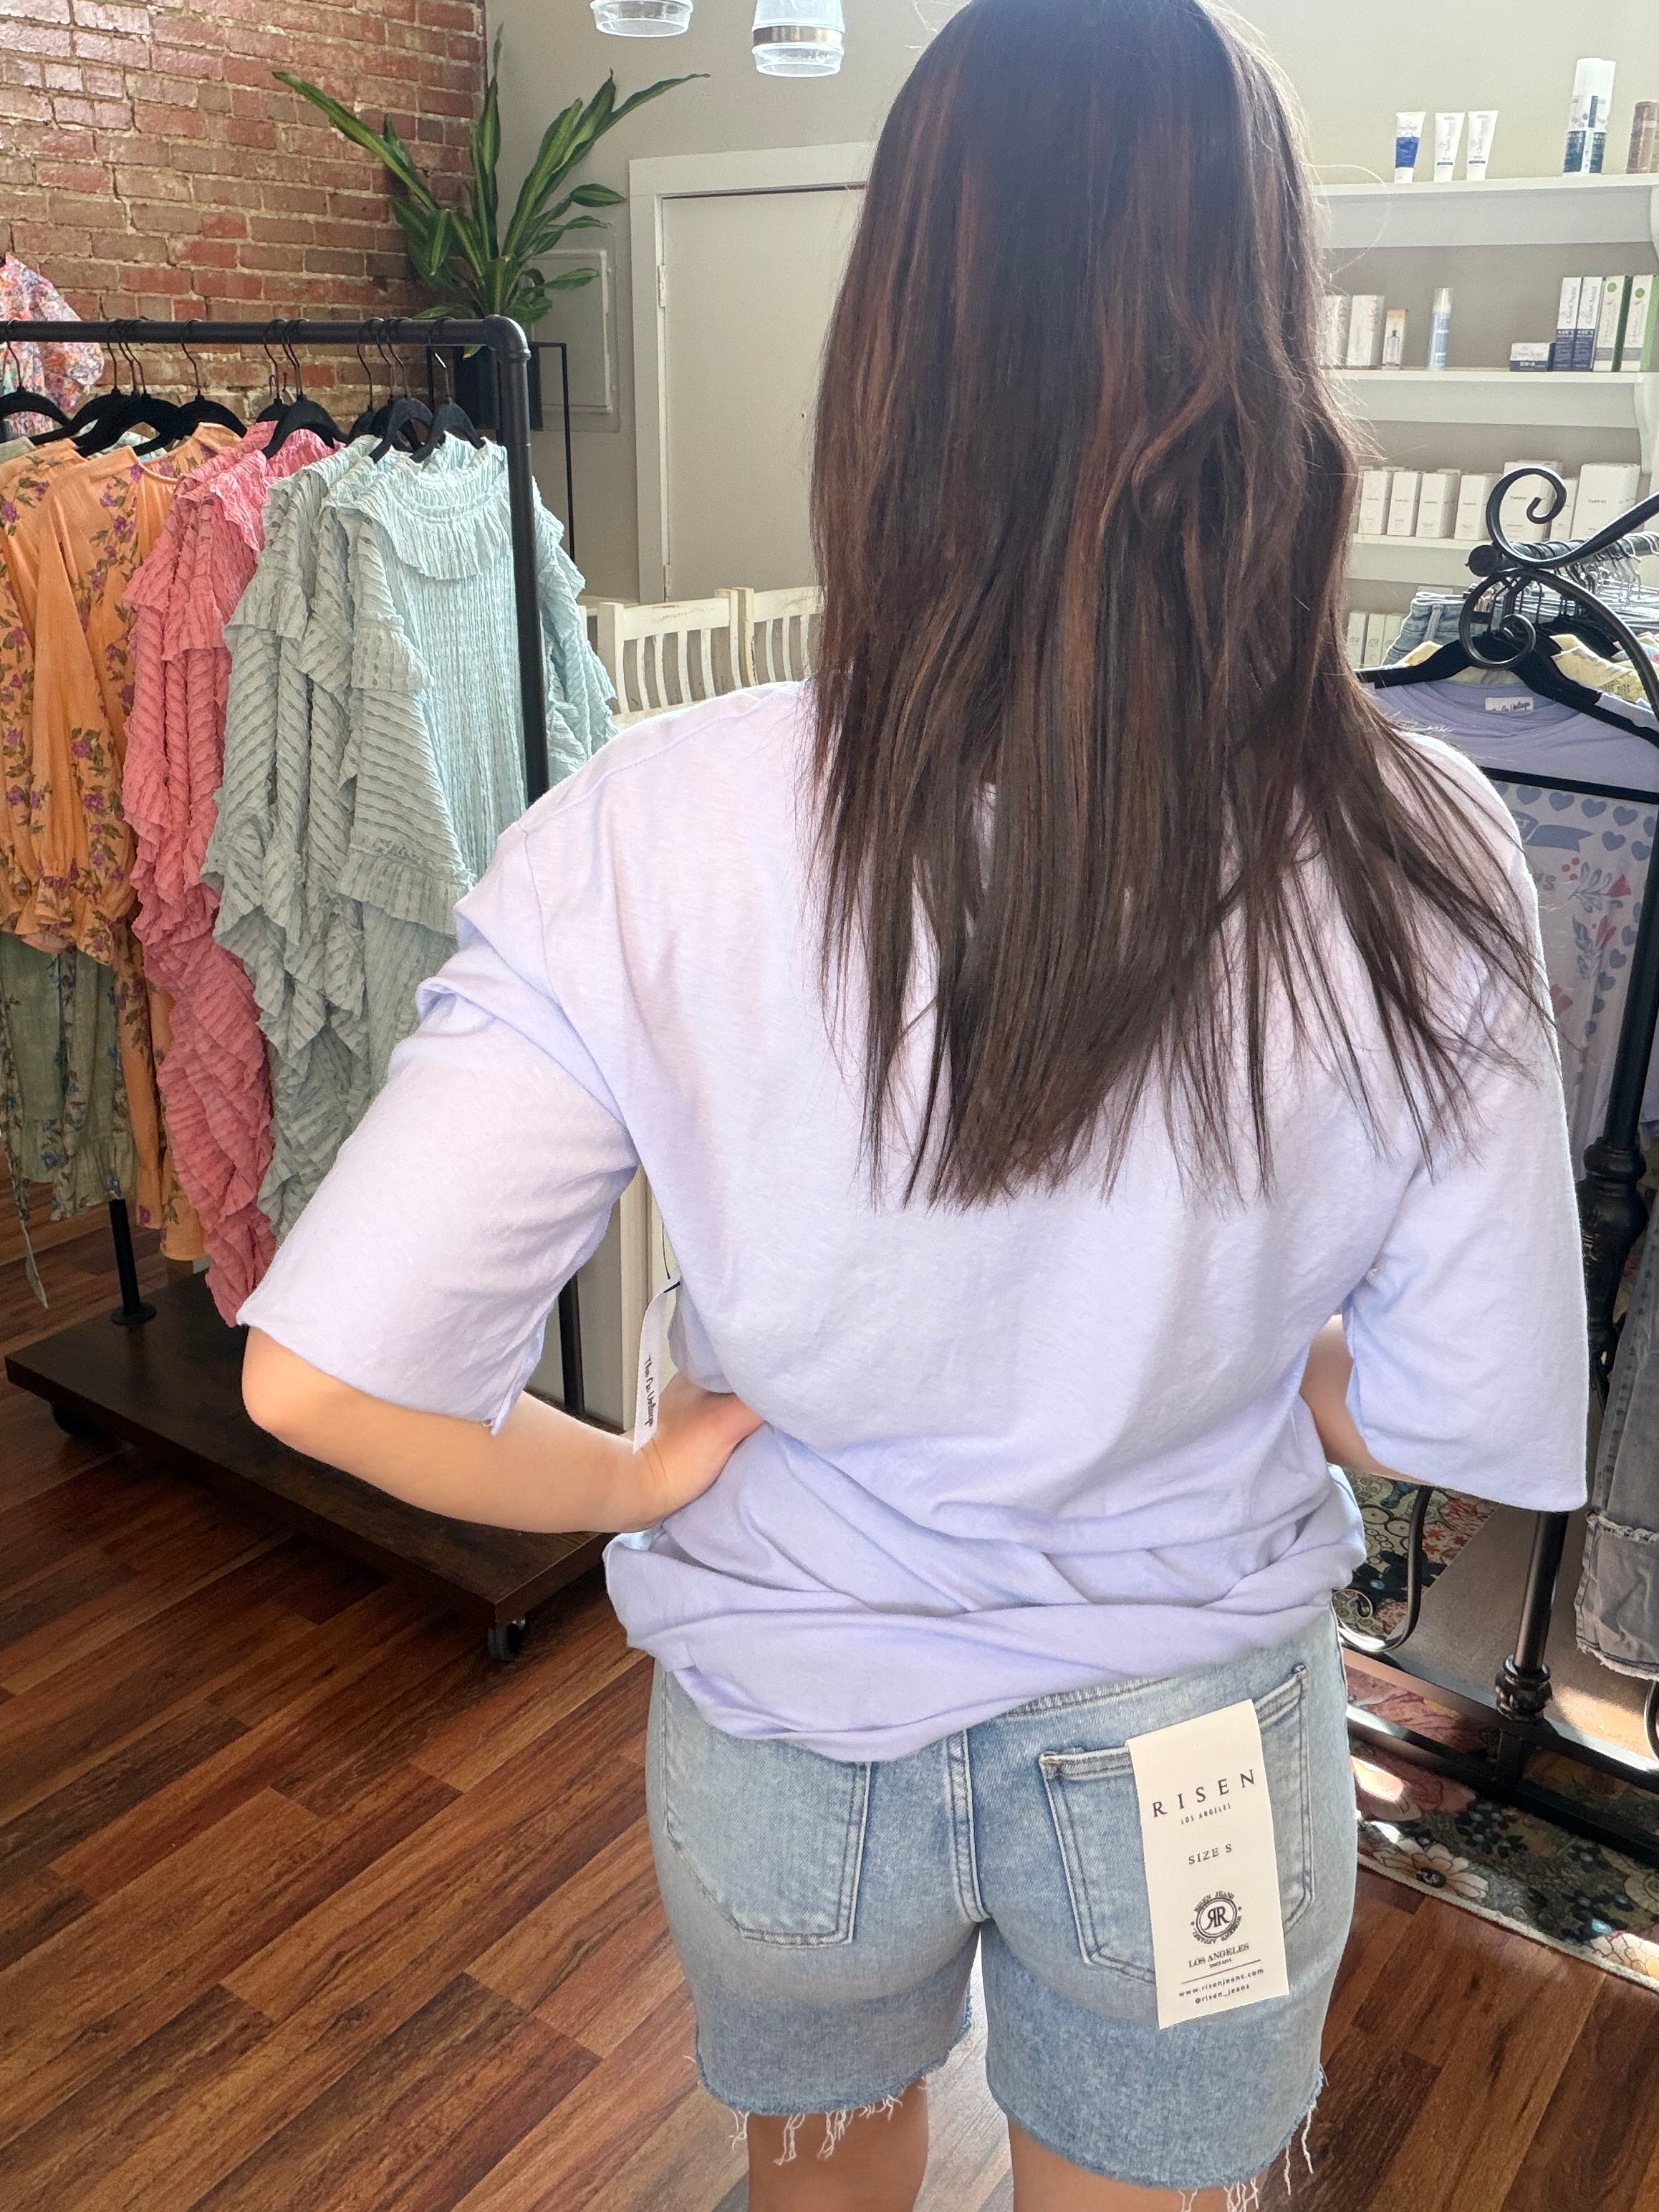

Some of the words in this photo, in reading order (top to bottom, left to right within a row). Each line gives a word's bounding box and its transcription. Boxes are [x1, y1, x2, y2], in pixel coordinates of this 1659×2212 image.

[1152, 1769, 1255, 1818] RISEN
[1180, 1814, 1194, 1825] LOS
[1198, 1802, 1231, 1819] ANGELES
[1188, 1847, 1219, 1865] SIZE
[1225, 1843, 1232, 1853] S
[1188, 1956, 1206, 1968] LOS
[1207, 1943, 1250, 1963] ANGELES
[1178, 1968, 1264, 1997] www.risenjeans.com
[1194, 1984, 1250, 2004] @risen_jeans
